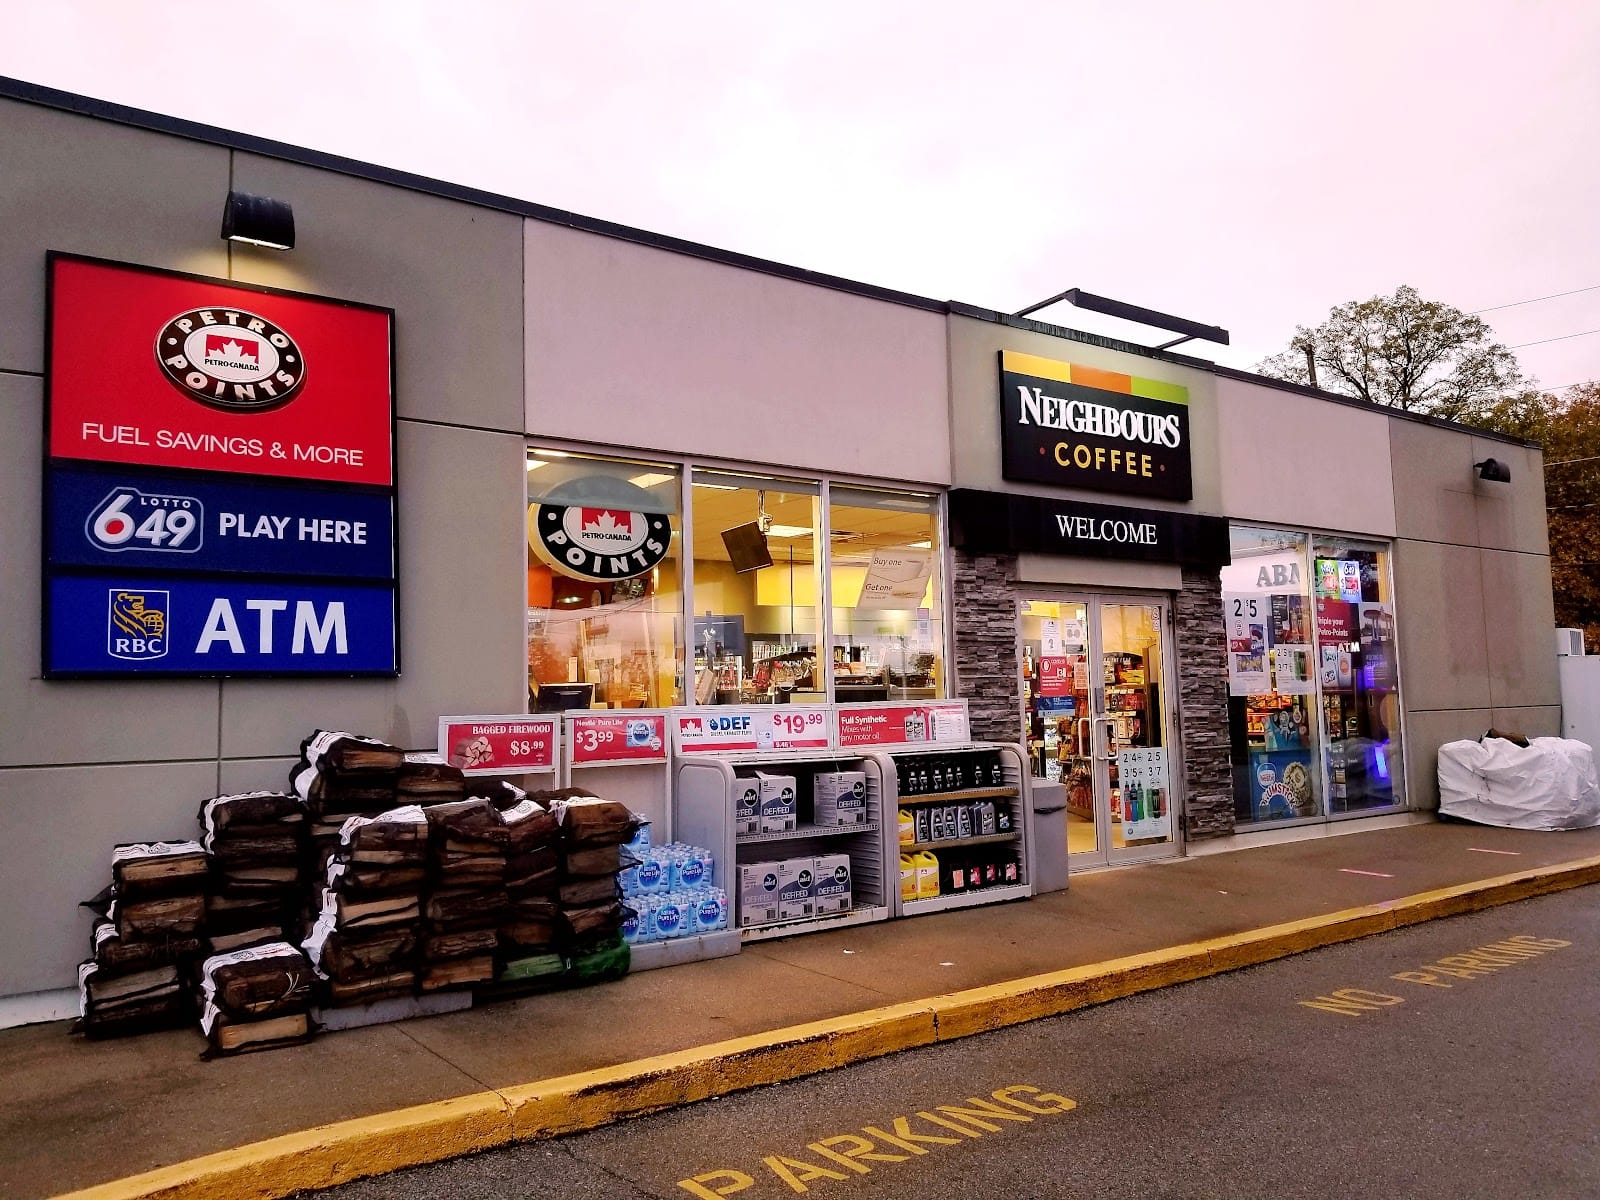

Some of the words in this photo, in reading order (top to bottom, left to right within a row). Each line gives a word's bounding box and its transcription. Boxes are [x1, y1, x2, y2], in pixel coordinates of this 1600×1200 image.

[175, 311, 289, 348] PETRO
[165, 354, 295, 401] POINTS
[1017, 386, 1180, 448] NEIGHBOURS
[82, 422, 149, 446] FUEL
[156, 430, 263, 457] SAVINGS
[269, 441, 287, 459] &
[293, 443, 364, 467] MORE
[1054, 442, 1153, 477] COFFEE
[140, 497, 191, 509] LOTTO
[219, 513, 291, 540] PLAY
[298, 517, 367, 545] HERE
[1056, 514, 1157, 545] WELCOME
[547, 530, 663, 574] POINTS
[873, 557, 888, 567] Buy
[865, 583, 879, 591] Get
[1233, 598, 1243, 617] 2
[195, 597, 349, 654] ATM
[1317, 616, 1331, 626] Triple
[1331, 618, 1344, 628] your
[115, 638, 162, 654] RBC
[1337, 641, 1360, 653] ATM
[598, 719, 611, 727] Pure
[612, 718, 624, 727] Life
[720, 716, 751, 731] DEF
[773, 713, 823, 735] $19.99
[841, 716, 854, 725] Full
[855, 714, 888, 725] Synthetic
[472, 726, 506, 735] BAGGED
[508, 724, 551, 734] FIREWOOD
[853, 733, 871, 741] motor
[872, 731, 880, 740] oil
[510, 740, 545, 757] $8.99
[1297, 988, 1406, 1017] NO
[1390, 935, 1573, 988] PARKING
[676, 1084, 1078, 1200] PARKING
